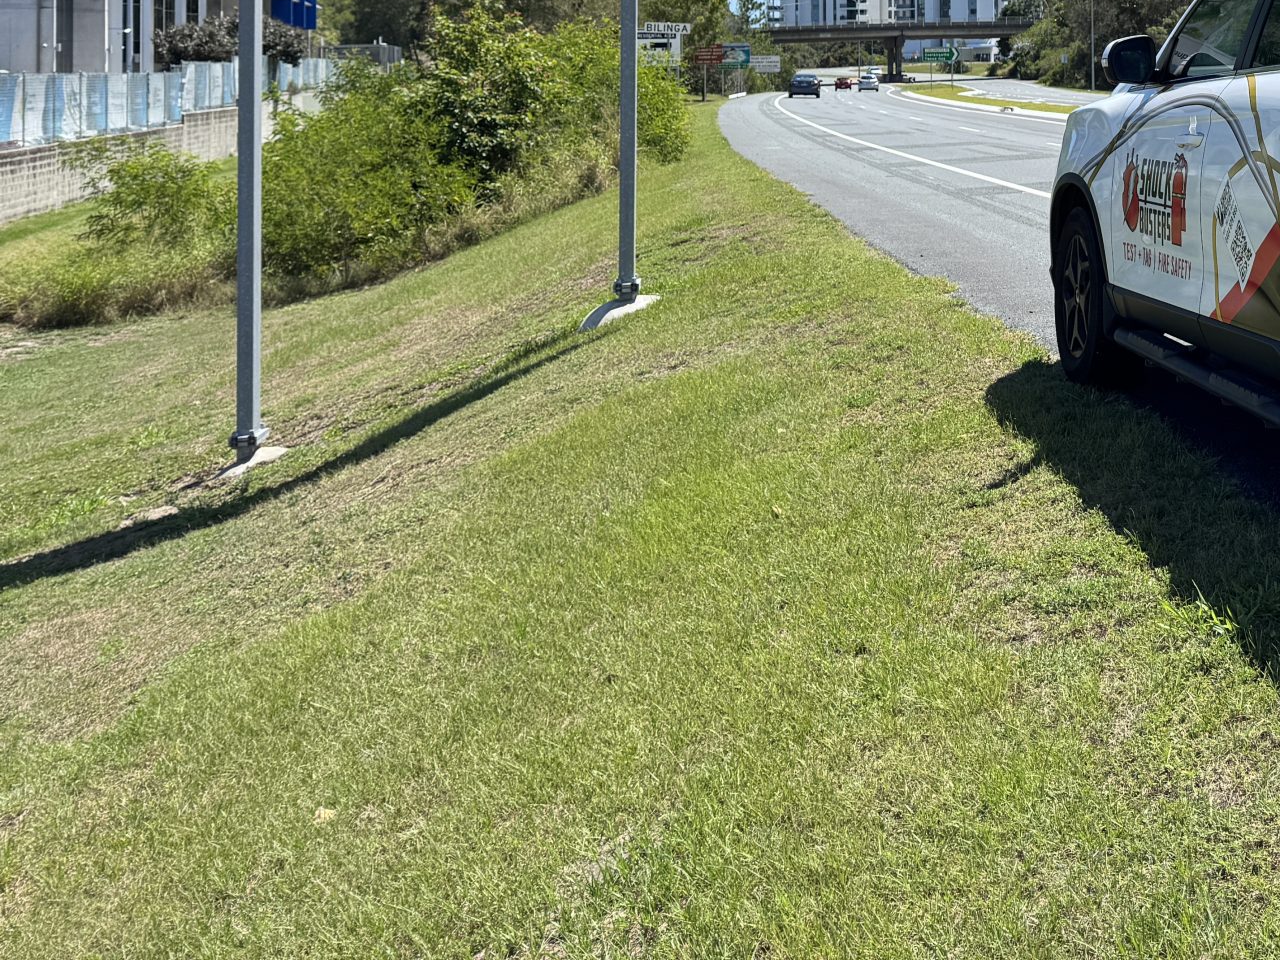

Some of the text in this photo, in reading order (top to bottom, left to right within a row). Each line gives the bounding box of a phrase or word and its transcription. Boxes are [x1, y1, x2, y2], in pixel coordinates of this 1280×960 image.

[646, 23, 688, 33] BILINGA
[1139, 158, 1175, 209] SHOCK
[1139, 205, 1171, 246] BUSTERS
[1122, 242, 1137, 263] TEST
[1142, 246, 1152, 268] TAG
[1158, 251, 1169, 274] FIRE
[1170, 256, 1192, 280] SAFETY
